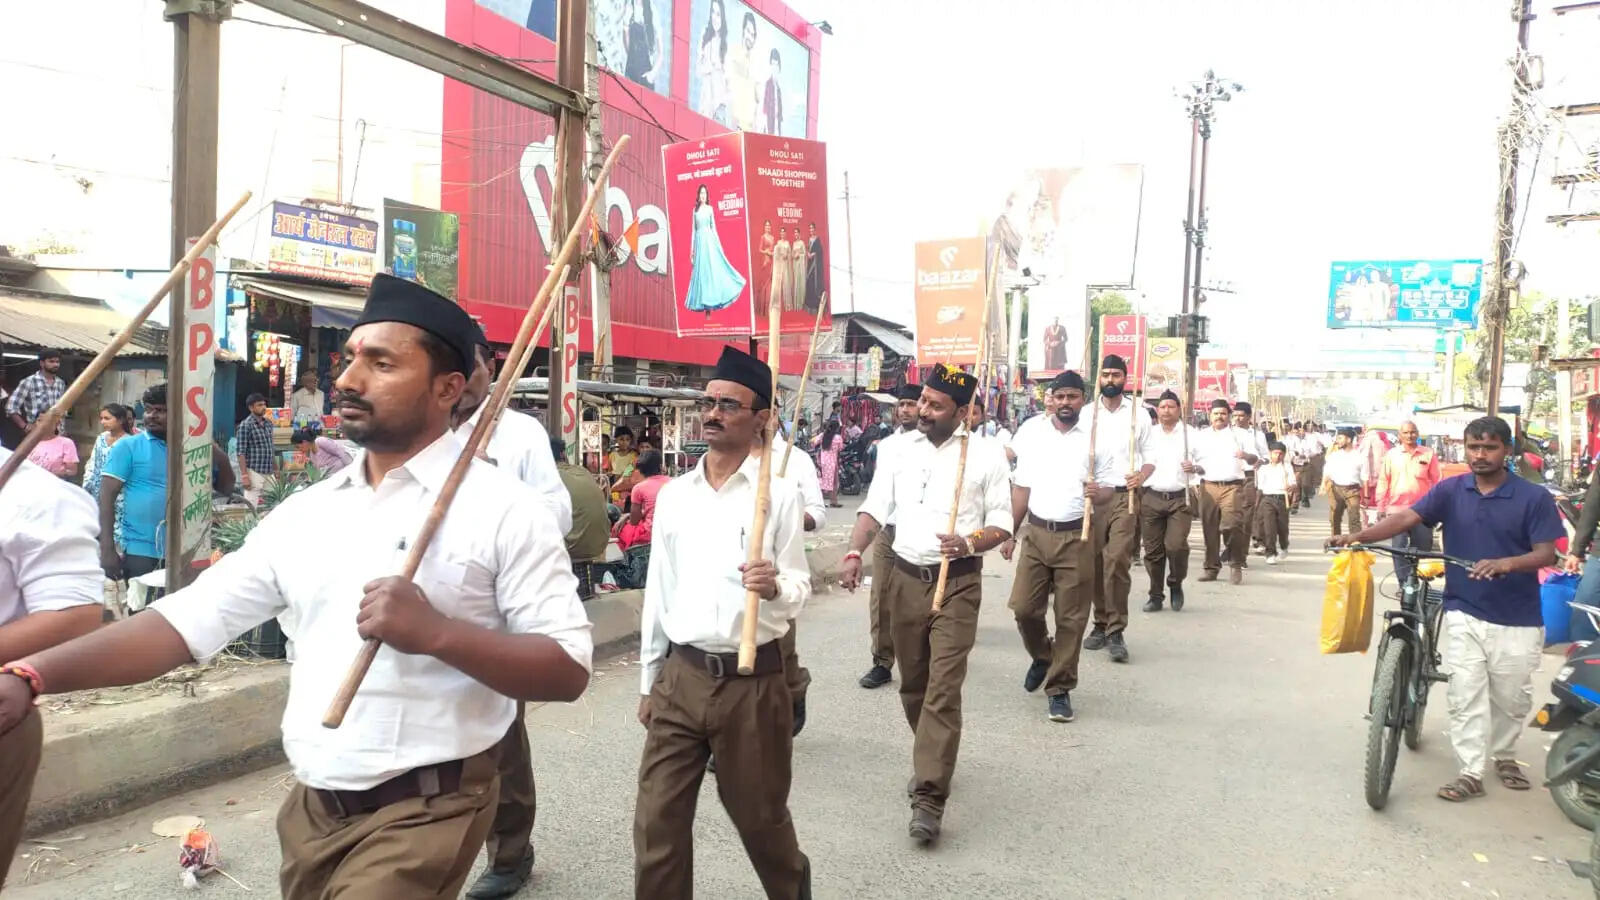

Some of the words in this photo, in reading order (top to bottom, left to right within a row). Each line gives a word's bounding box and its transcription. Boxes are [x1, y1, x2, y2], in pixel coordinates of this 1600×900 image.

[757, 167, 783, 177] SHAADI
[783, 169, 817, 180] SHOPPING
[771, 177, 805, 189] TOGETHER
[717, 197, 744, 211] WEDDING
[777, 207, 803, 218] WEDDING
